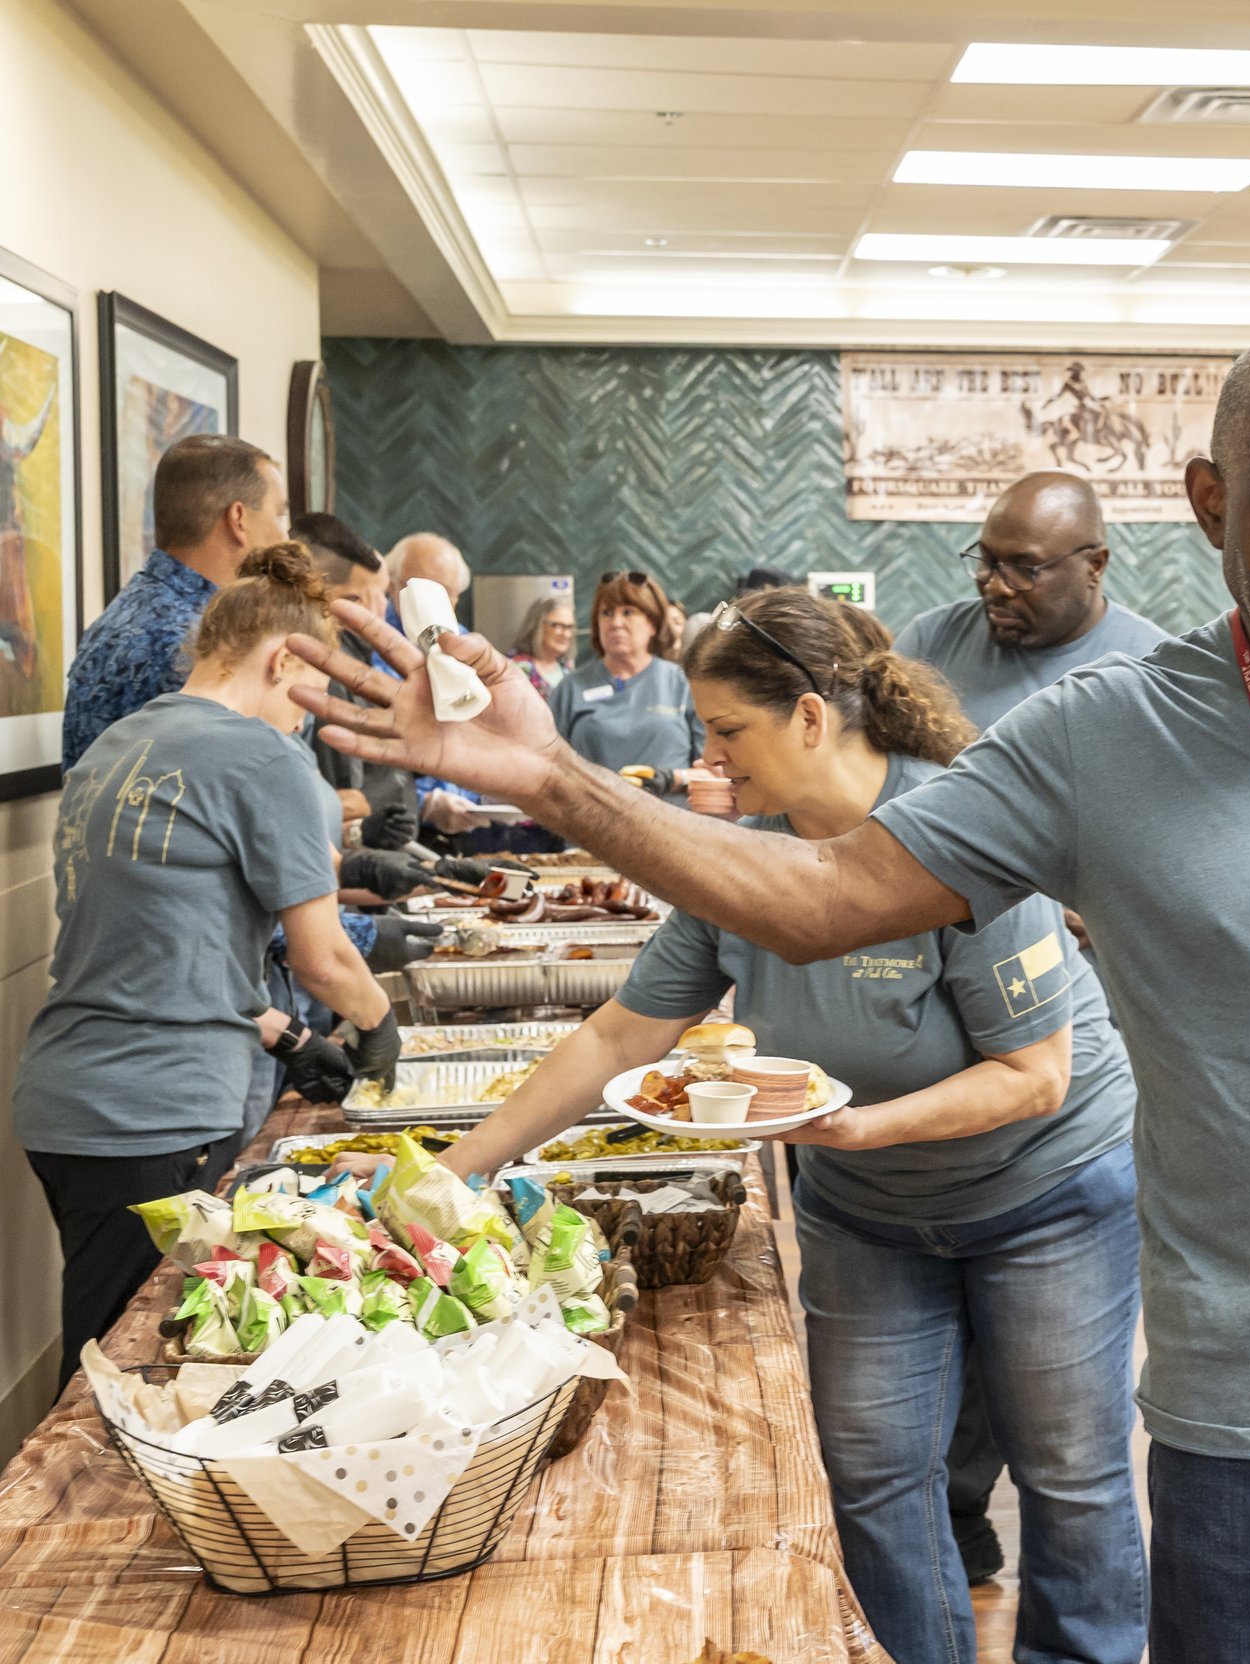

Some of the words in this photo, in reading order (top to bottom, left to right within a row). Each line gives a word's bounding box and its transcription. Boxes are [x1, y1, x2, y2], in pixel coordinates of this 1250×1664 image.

[956, 369, 989, 392] THE
[1000, 370, 1041, 392] BEST
[1119, 372, 1143, 394] NO
[852, 480, 959, 495] FOURSQUARE
[1116, 482, 1147, 496] ALL
